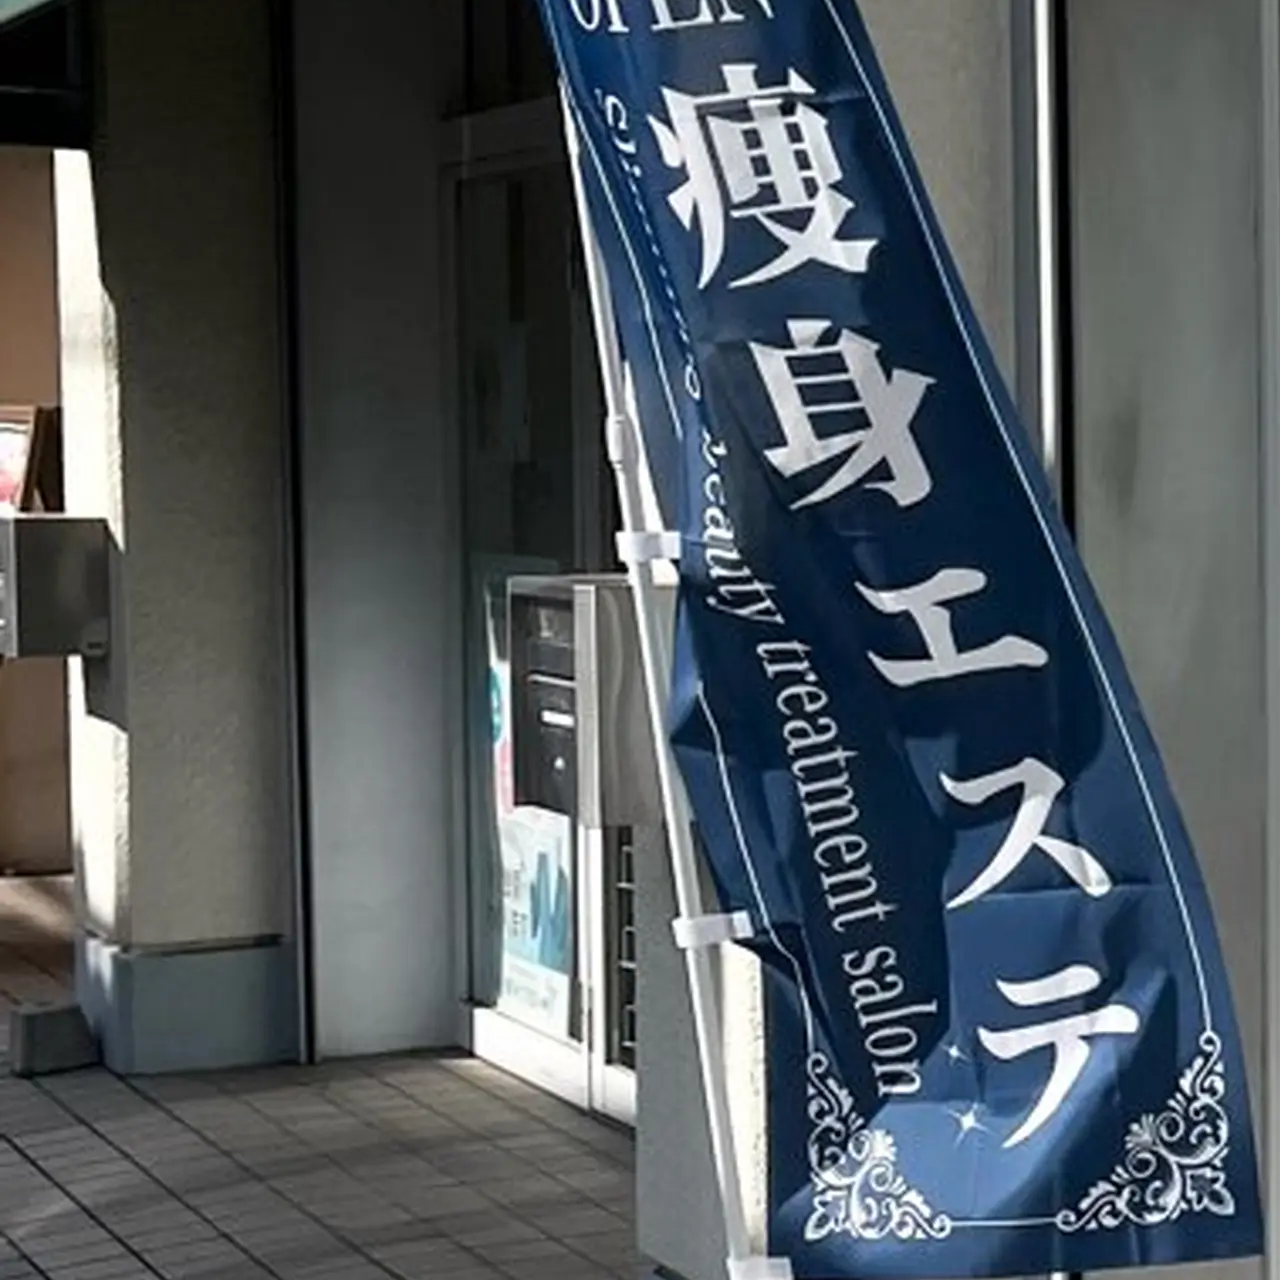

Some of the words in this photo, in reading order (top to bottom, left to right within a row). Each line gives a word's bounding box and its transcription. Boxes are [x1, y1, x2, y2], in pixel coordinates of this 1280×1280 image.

[647, 62, 1140, 1150] 痩身エステ
[756, 639, 898, 933] treatment
[842, 945, 939, 1098] salon
